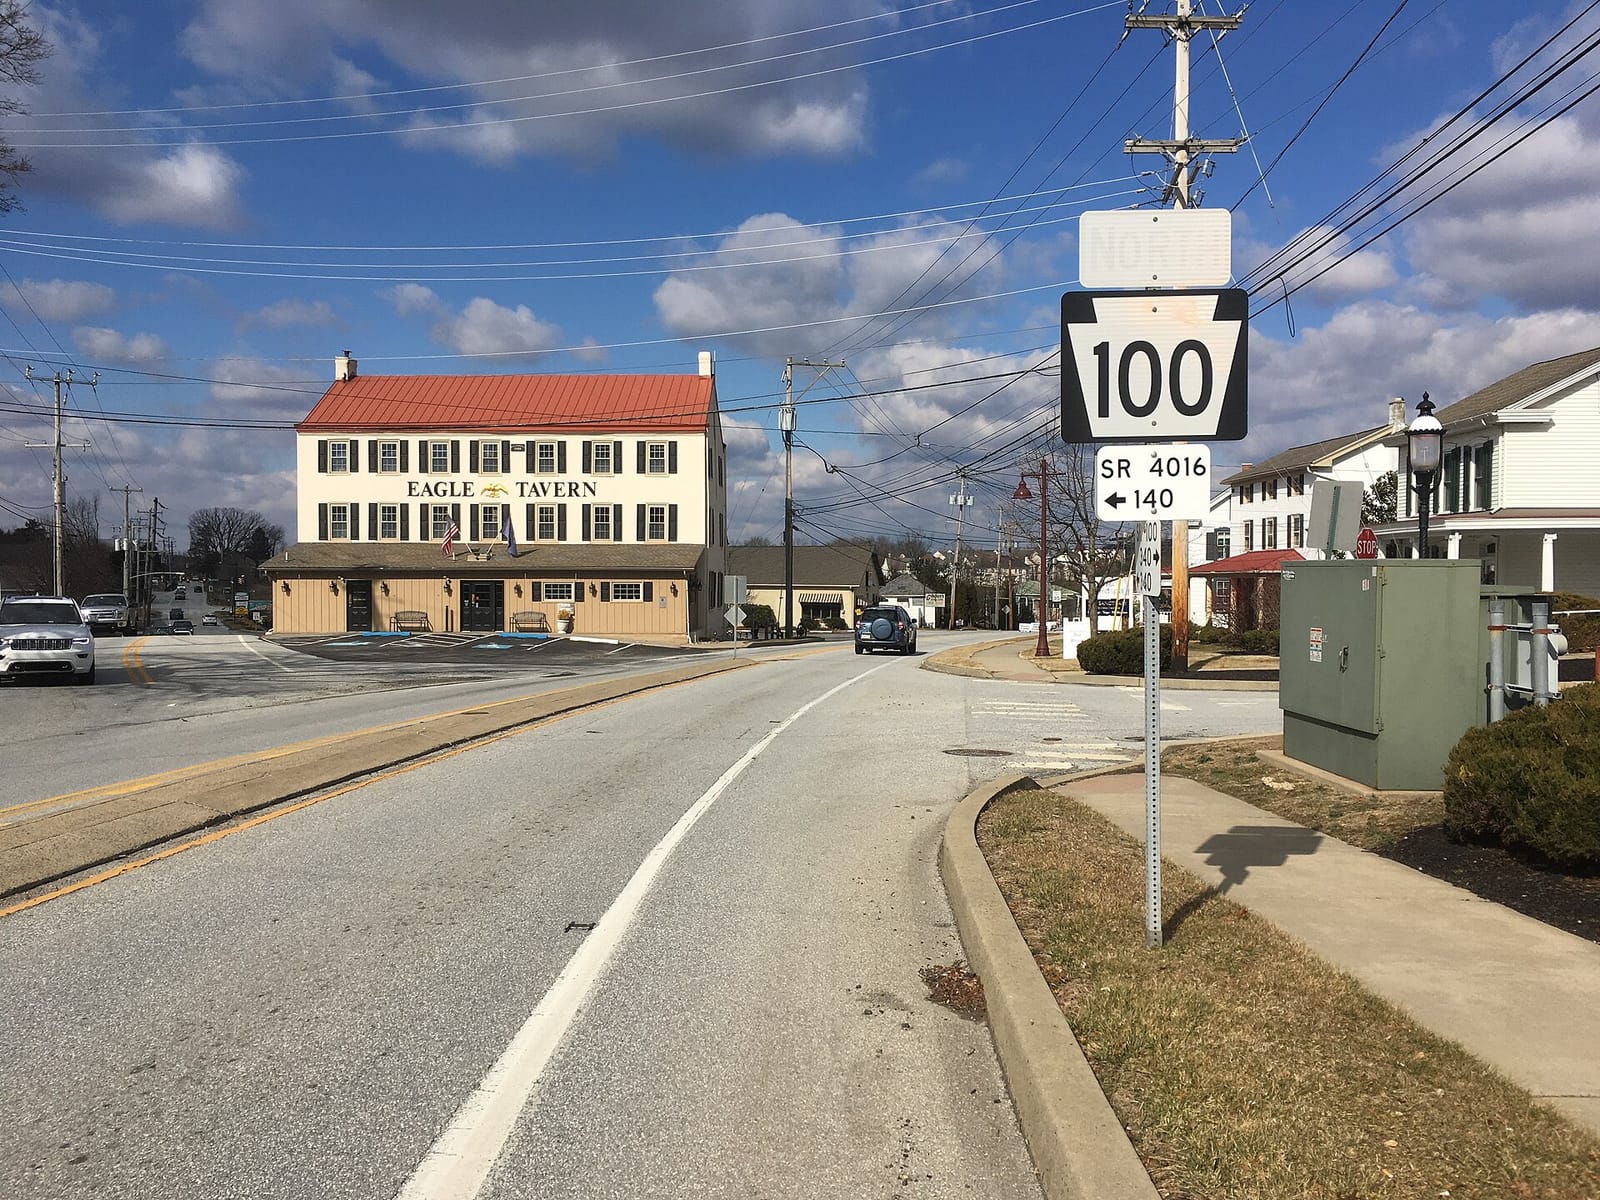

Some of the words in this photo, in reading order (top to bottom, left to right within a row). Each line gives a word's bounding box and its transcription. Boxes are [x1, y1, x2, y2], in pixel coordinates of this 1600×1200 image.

[1093, 339, 1213, 418] 100
[1101, 459, 1131, 479] SR
[1149, 457, 1206, 478] 4016
[407, 481, 475, 498] EAGLE
[515, 481, 598, 498] TAVERN
[1134, 488, 1174, 509] 140
[1357, 540, 1376, 554] STOP
